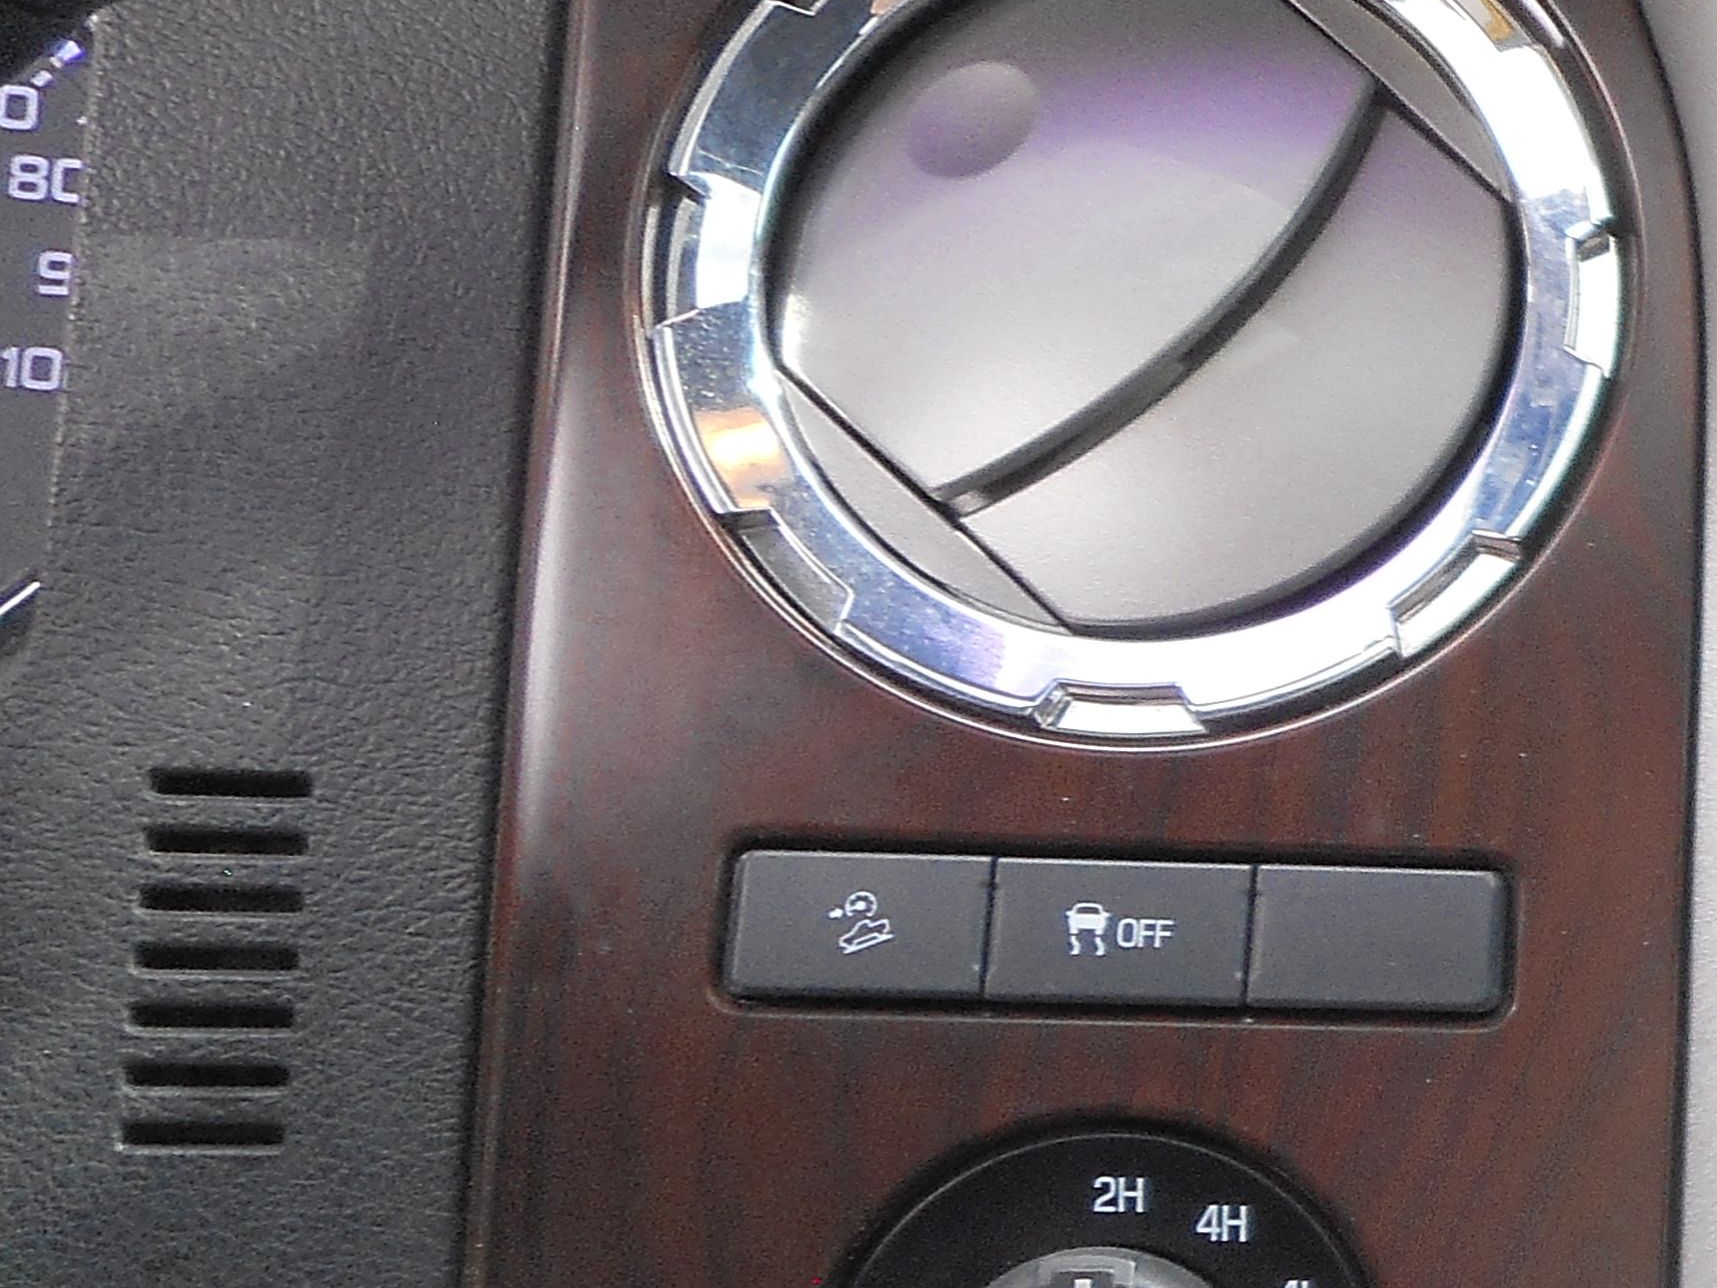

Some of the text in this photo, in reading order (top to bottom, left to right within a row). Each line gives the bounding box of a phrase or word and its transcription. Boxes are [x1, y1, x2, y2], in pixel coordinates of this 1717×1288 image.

[1116, 917, 1175, 948] OFF
[1093, 1176, 1145, 1213] 2H
[1195, 1204, 1248, 1243] 4H
